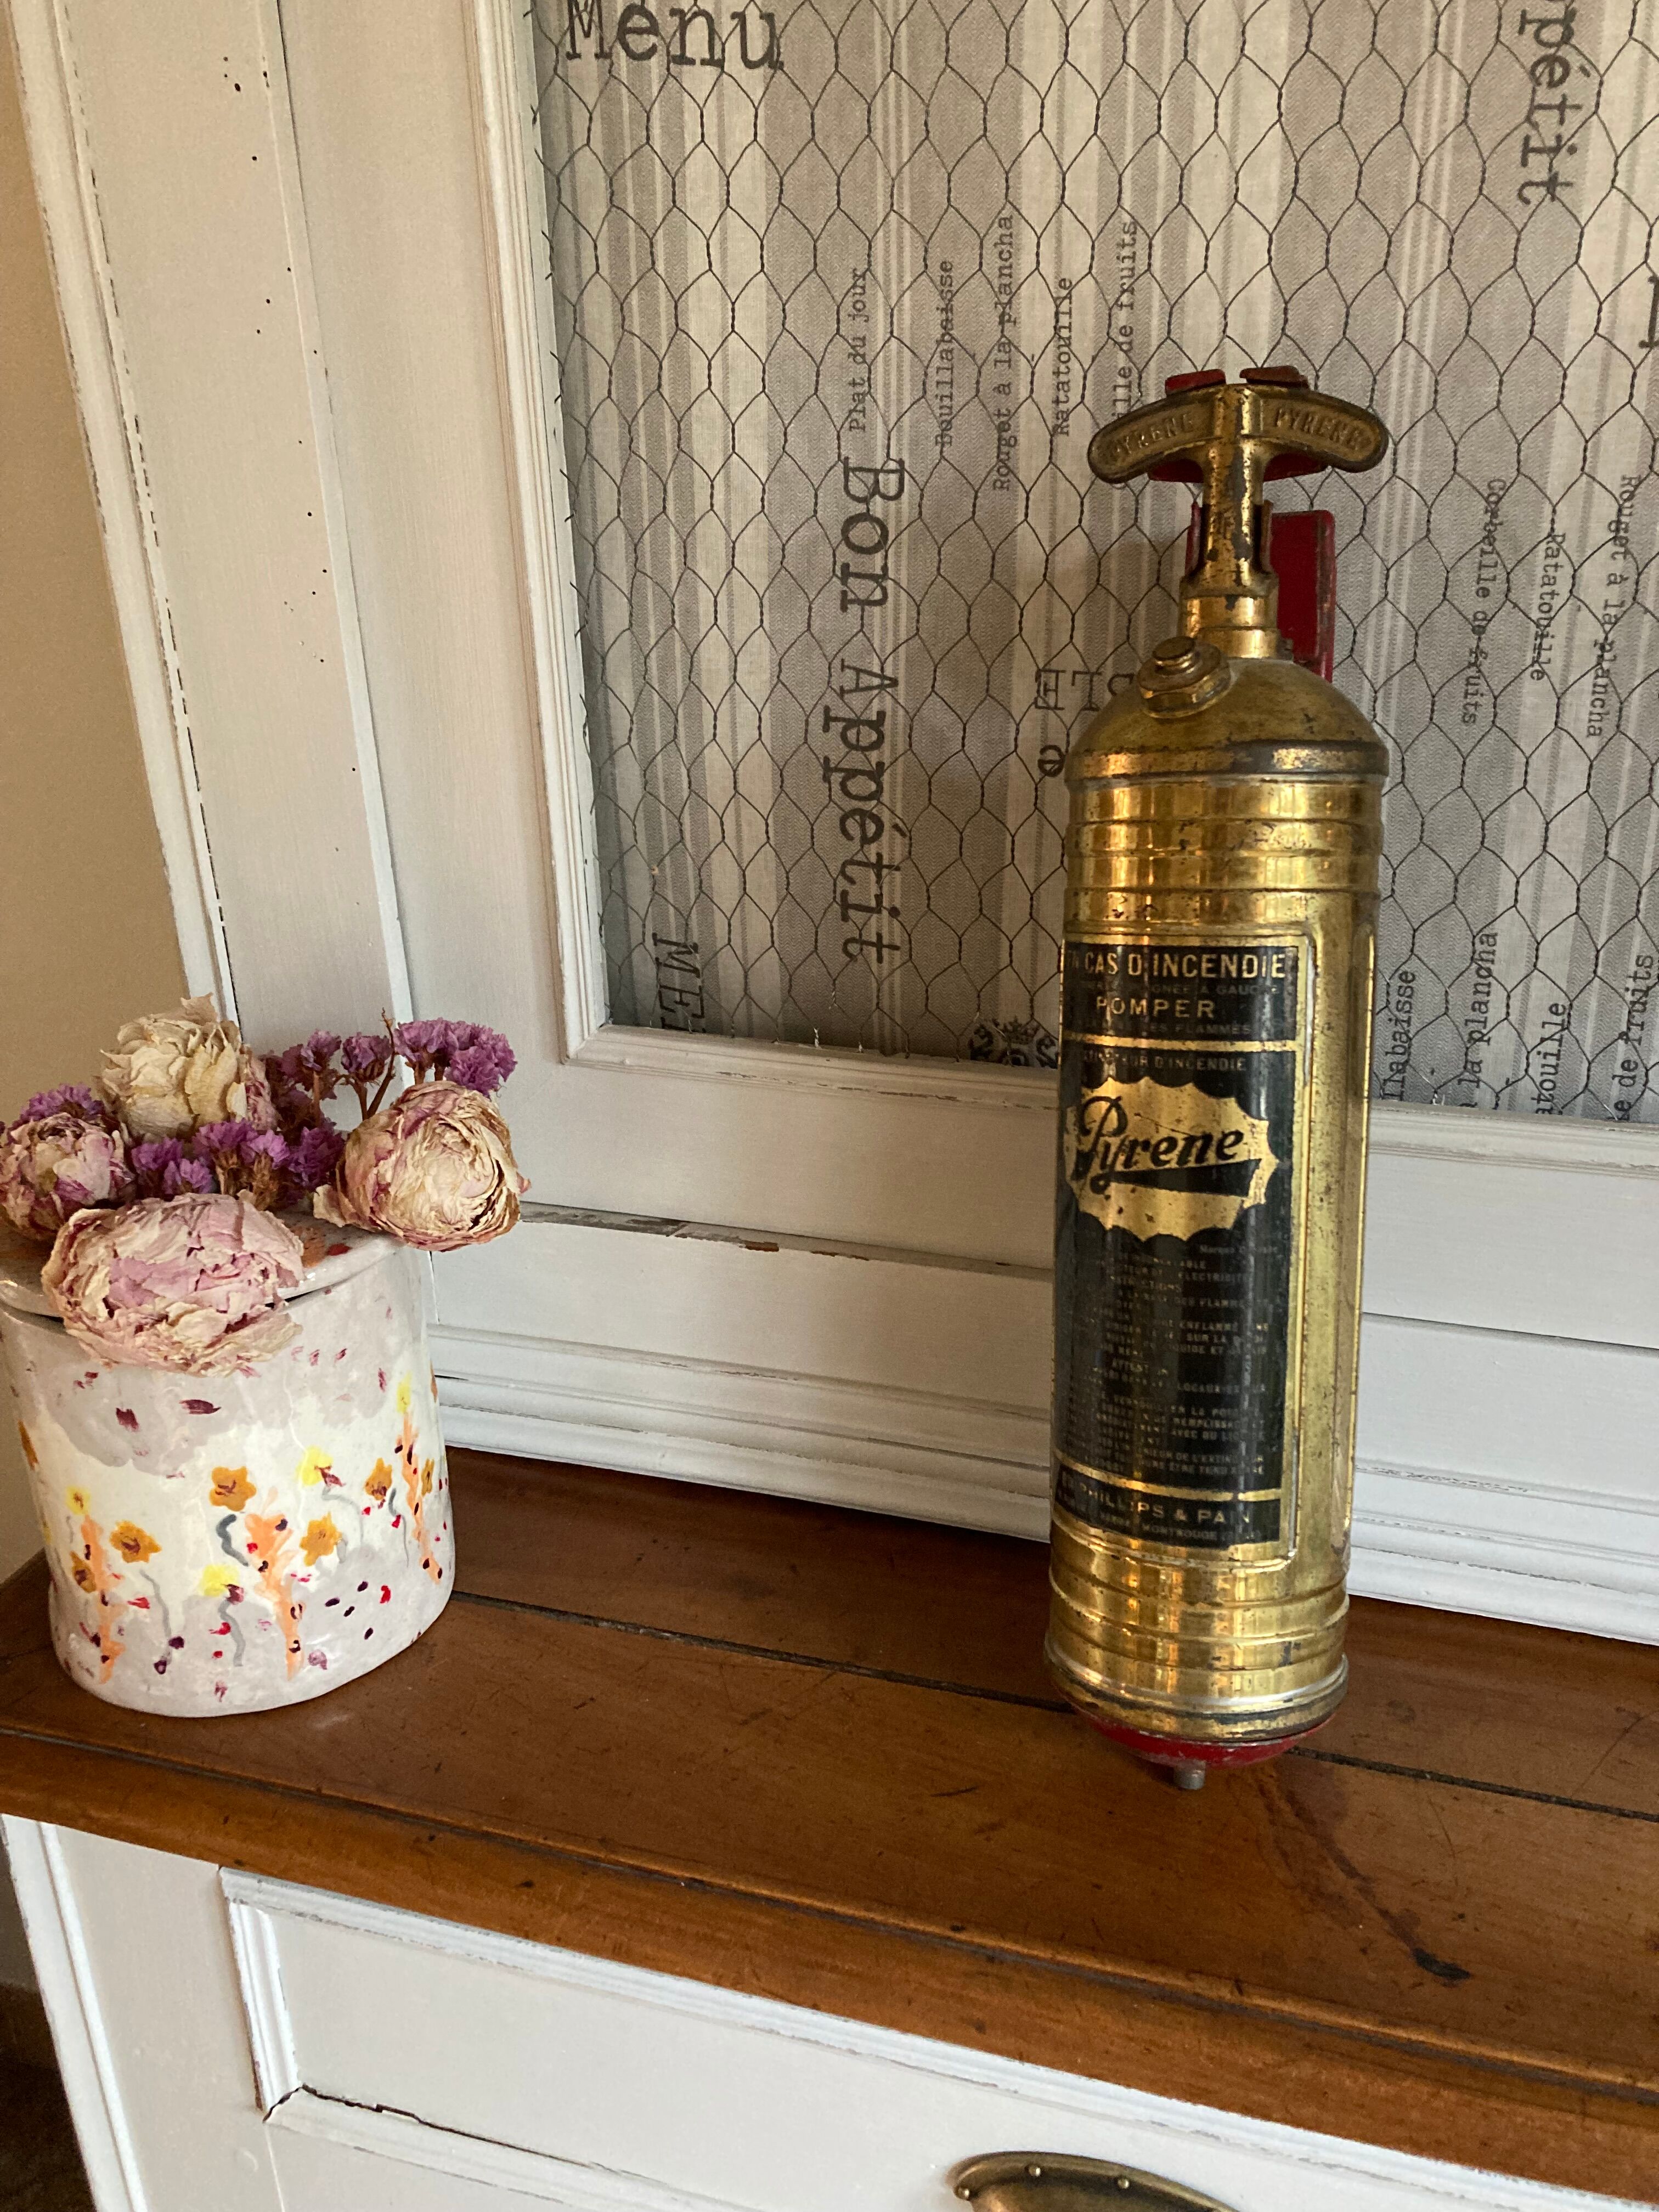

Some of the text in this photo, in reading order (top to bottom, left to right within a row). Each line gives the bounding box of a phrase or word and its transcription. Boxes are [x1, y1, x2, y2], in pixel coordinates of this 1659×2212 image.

[566, 0, 785, 70] Menu
[1517, 0, 1590, 205] pétit
[994, 215, 1017, 326] plancha
[1117, 221, 1137, 311] fruits
[848, 267, 870, 432] Plat du jour
[935, 260, 954, 447] Bouillabaisse
[994, 340, 1013, 368] la
[1052, 276, 1073, 436] Ratatouille
[1116, 324, 1134, 353] de
[993, 408, 1018, 491] Rouget
[1273, 406, 1365, 452] PYRENE
[1475, 478, 1506, 599] Corbeille
[1607, 474, 1640, 562] Rouget
[1530, 533, 1566, 681] Ratatouille
[1601, 599, 1626, 628] la
[822, 456, 908, 964] Bon Appétit
[1462, 646, 1489, 725] fruits
[1587, 639, 1617, 738] plancha
[1084, 951, 1120, 975] CAS
[1127, 952, 1286, 980] DINCENDIE
[1096, 996, 1215, 1019] POMPER
[1464, 932, 1499, 1046] plancha
[1618, 955, 1654, 1047] fruits
[1457, 1059, 1483, 1089] la
[1611, 1059, 1639, 1088] de
[1071, 1095, 1244, 1195] Pyrene
